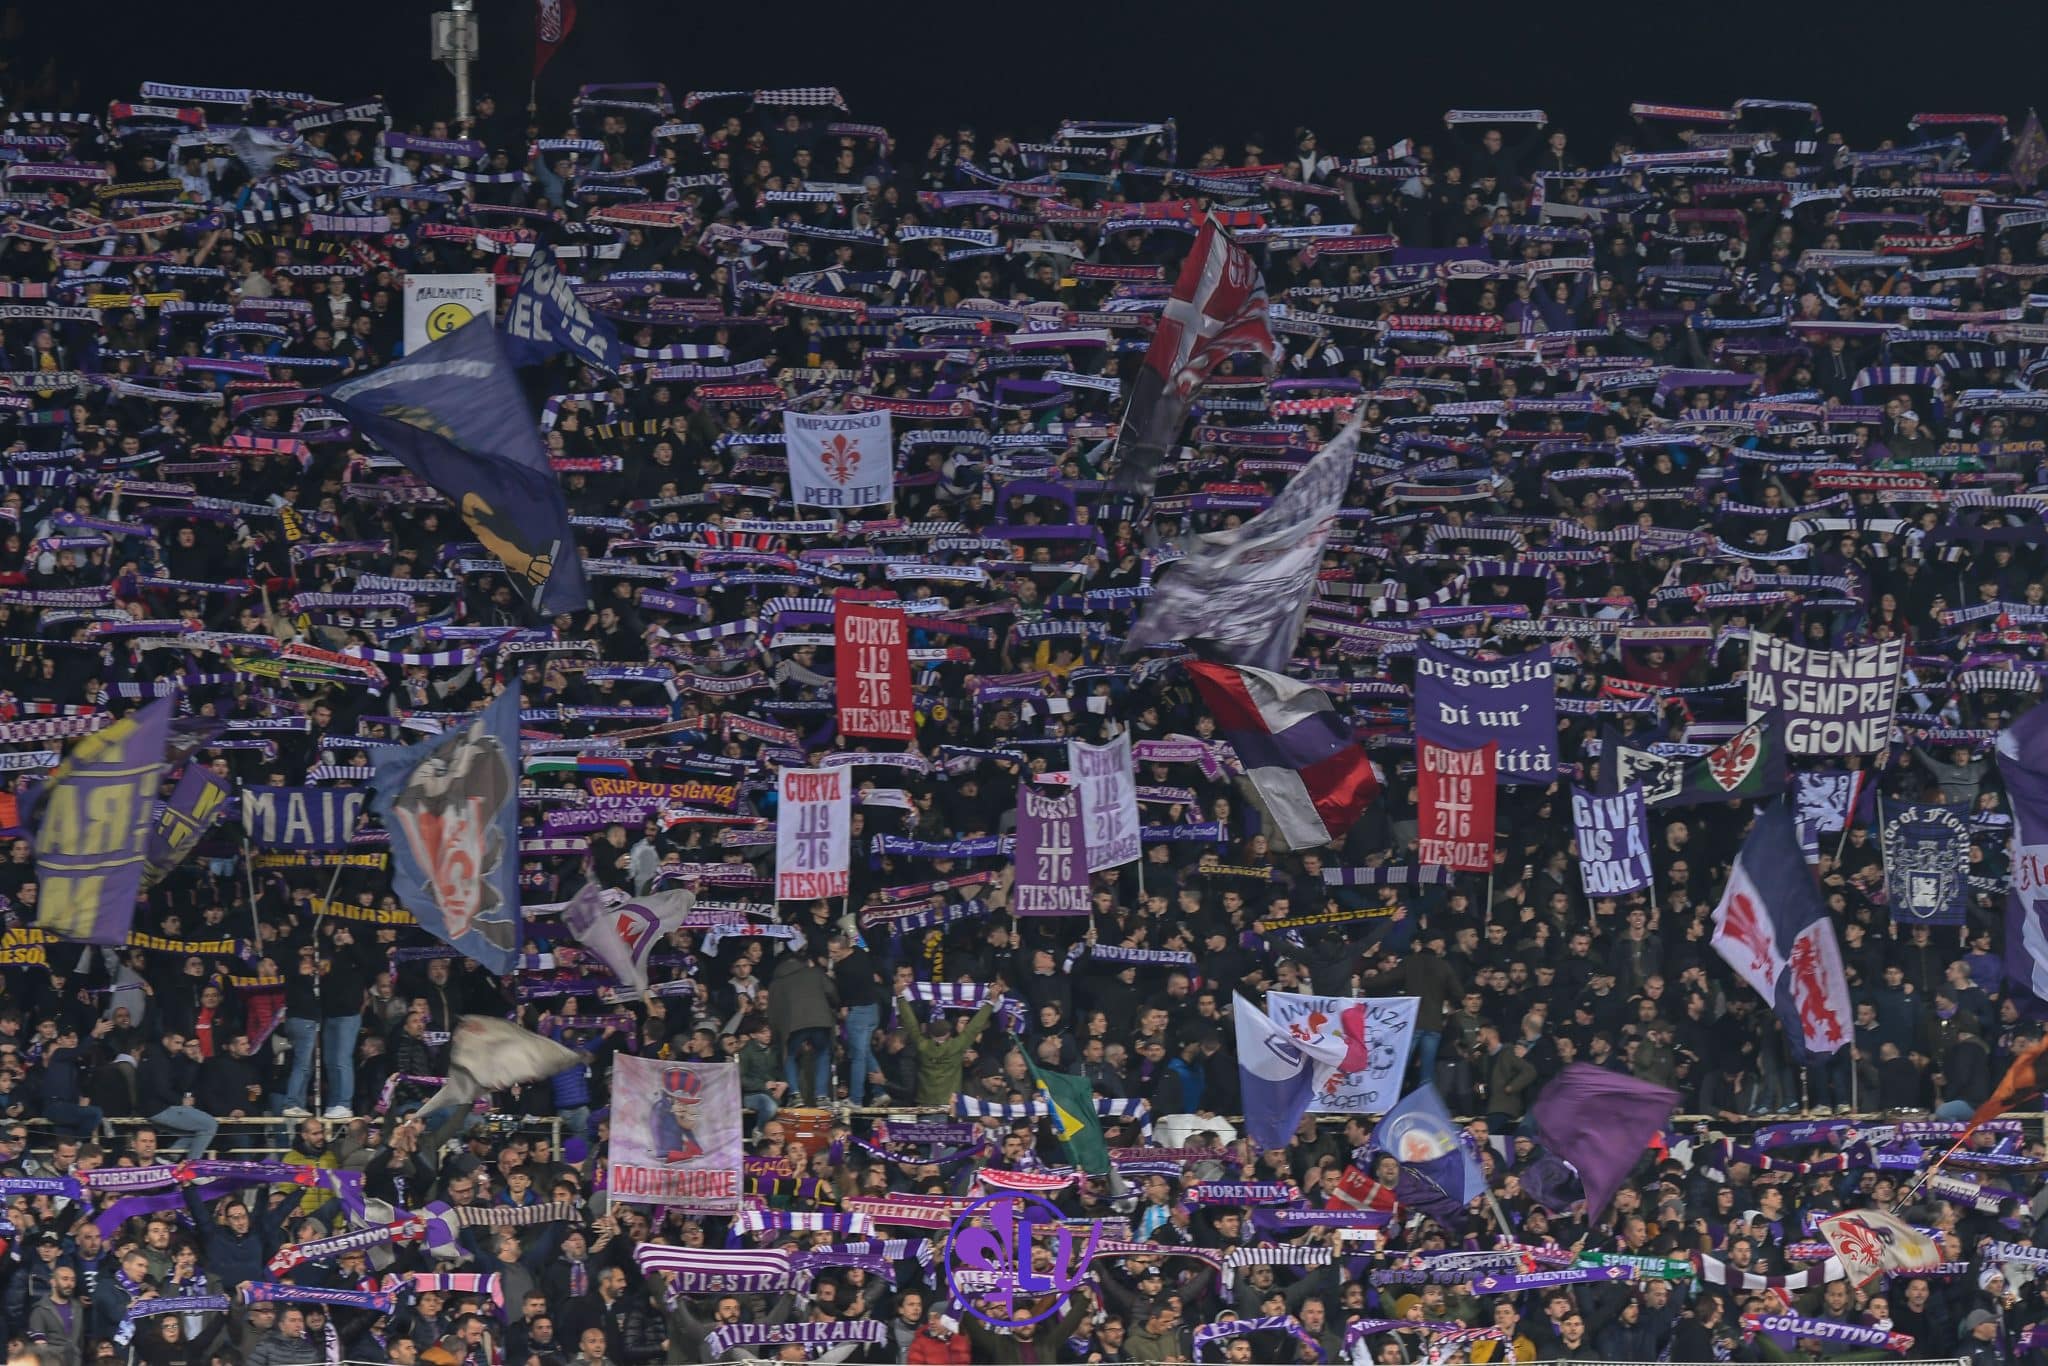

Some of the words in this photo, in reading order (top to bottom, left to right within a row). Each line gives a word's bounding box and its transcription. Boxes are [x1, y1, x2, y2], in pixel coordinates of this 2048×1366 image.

[145, 82, 189, 98] JUVE
[194, 87, 248, 102] MERDA
[1019, 143, 1107, 157] FIORENTINA
[1349, 166, 1421, 177] FIORENTINA
[1853, 188, 1940, 199] FIORENTIN
[1107, 219, 1179, 229] FIORENTINA
[905, 228, 937, 240] JUVE
[941, 229, 993, 244] MERDA
[159, 266, 224, 276] FIORENTINA
[635, 272, 687, 281] FIORENTINA
[1290, 284, 1374, 296] FIORENTINA
[1886, 297, 1950, 307] FIORENTINA
[1079, 313, 1137, 325] FIORENTINA
[1295, 309, 1378, 329] FIORENTINA
[1401, 315, 1485, 328] FIORENTINA
[796, 417, 881, 429] IMPAZZISCO
[1911, 456, 1961, 469] SPORTING
[649, 494, 704, 507] CAMPI
[805, 487, 844, 503] PER
[851, 486, 881, 503] TE!
[741, 520, 834, 532] INVIOLABILI
[1526, 550, 1604, 561] FIORENTINA
[37, 592, 101, 602] FIORENTINA
[296, 594, 412, 607] UNONOVEDUESEI
[1705, 593, 1751, 604] CUORE
[326, 613, 398, 628] 1926
[844, 615, 901, 645] CURVA
[1642, 628, 1707, 638] FIORENTINA
[624, 667, 643, 676] 25
[1417, 657, 1551, 689] orgoglio
[694, 679, 752, 691] FIORENTINA
[1749, 672, 1776, 706] HA
[1784, 682, 1895, 713] SEMPRE
[842, 708, 912, 735] FIESOLE
[1439, 702, 1470, 726] di
[1475, 704, 1528, 727] un'
[1785, 717, 1889, 754] GiONE
[1424, 745, 1485, 775] CURVA
[1495, 746, 1552, 772] tità
[591, 778, 665, 798] GRUPPO
[785, 773, 842, 801] CURVA
[1026, 792, 1079, 819] CURVA
[1573, 792, 1639, 829] GIVE
[549, 810, 598, 826] GRUPPO
[1580, 829, 1613, 862] US
[1628, 825, 1644, 857] A
[780, 871, 849, 899] FIESOLE
[1017, 885, 1092, 911] FIESOLE
[90, 1168, 172, 1187] FIORENTINA
[614, 1165, 737, 1197] MONTAIONE
[1199, 1185, 1288, 1199] FIORENTINA
[852, 1202, 948, 1221] FIORENTINA
[301, 1223, 390, 1258] COLLETTIVO
[1602, 1254, 1666, 1273] SPORTING
[1516, 1271, 1587, 1282] FIORENTINA
[274, 1285, 368, 1304] Fiorentina
[1763, 1316, 1887, 1344] COLLETTIVO
[718, 1325, 766, 1353] TIPI
